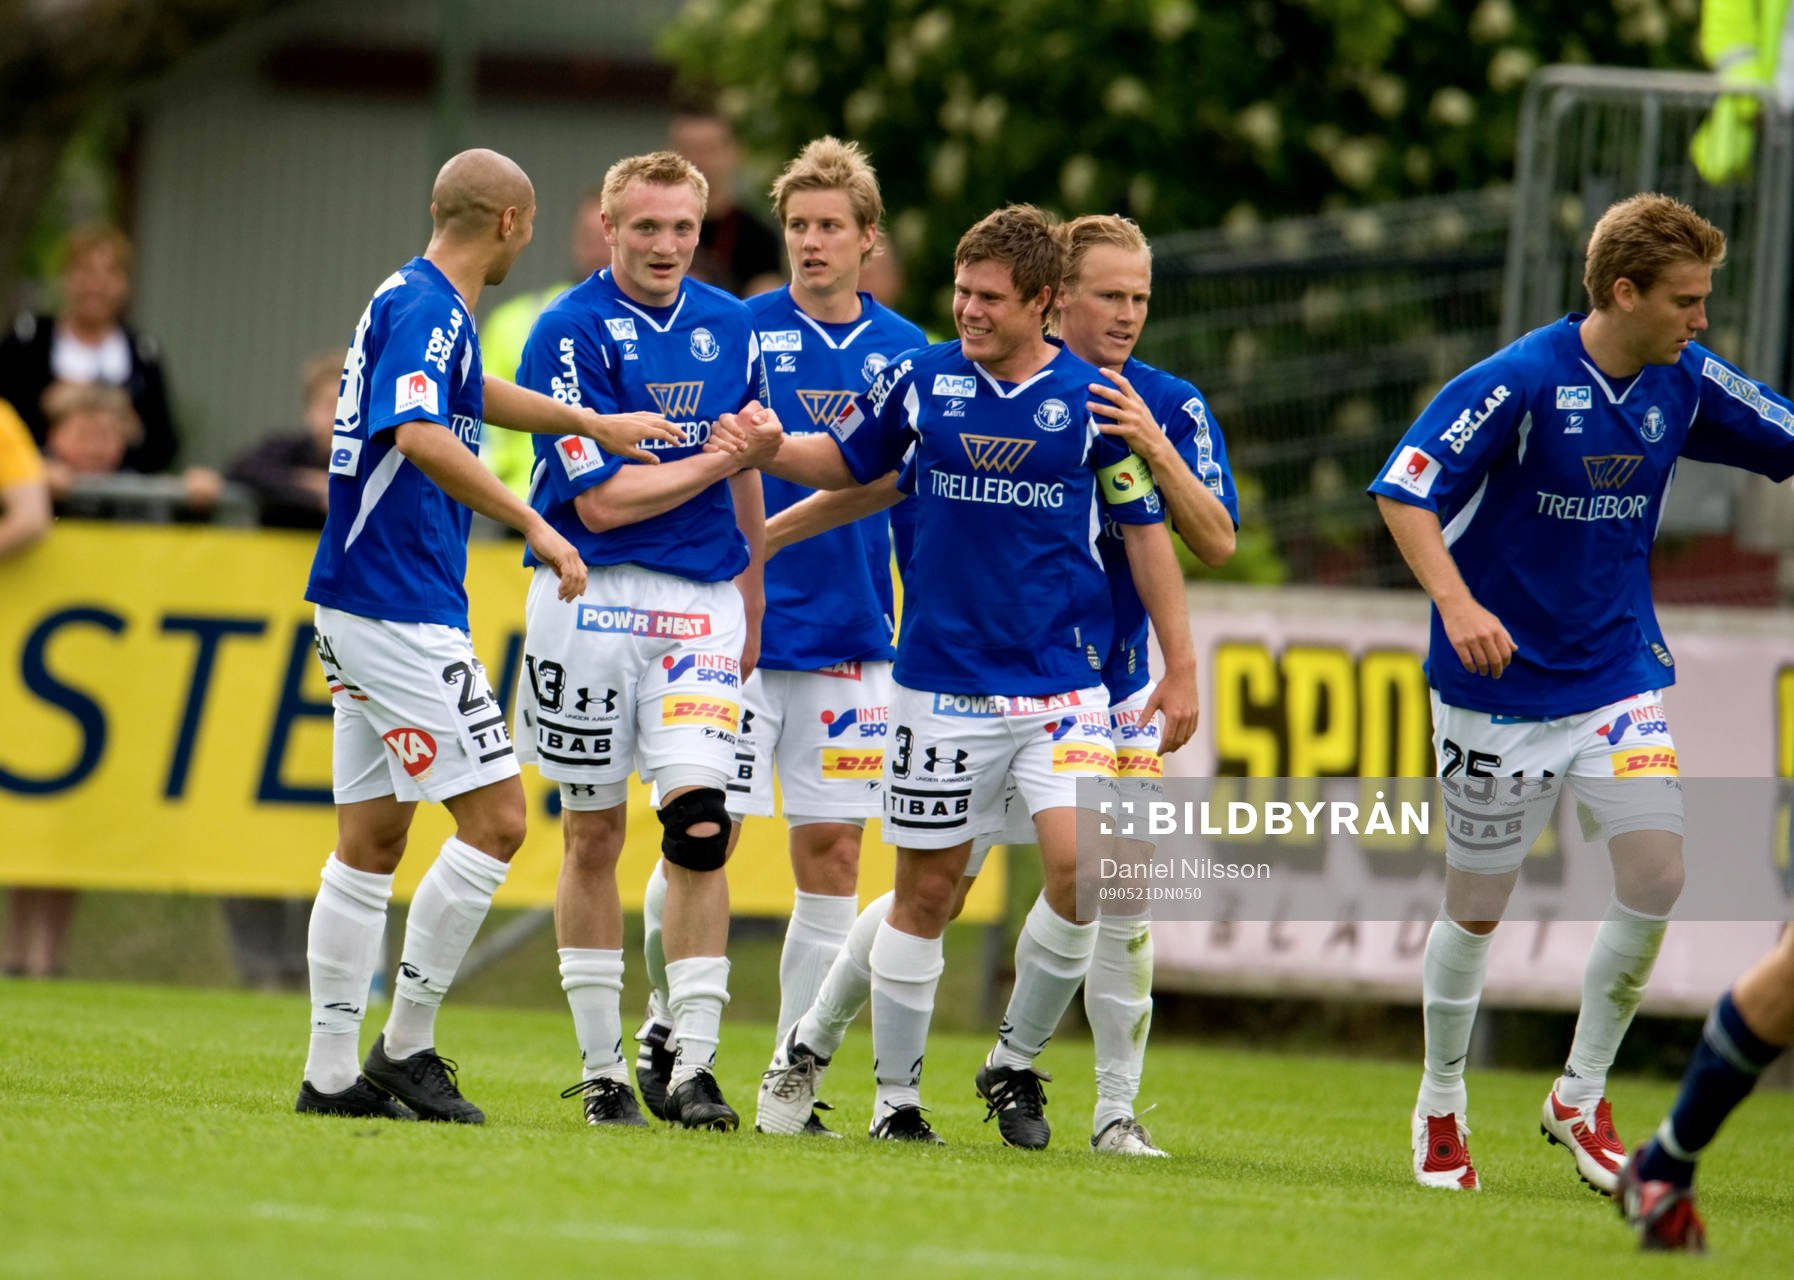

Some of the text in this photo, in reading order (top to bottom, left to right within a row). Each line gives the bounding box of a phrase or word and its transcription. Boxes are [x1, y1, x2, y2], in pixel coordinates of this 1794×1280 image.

[425, 327, 443, 363] TOP
[437, 308, 464, 374] DOLLAR
[551, 376, 568, 404] OP
[867, 373, 885, 405] TOP
[873, 359, 914, 419] DOLLAR
[1440, 408, 1471, 442] TOP
[1450, 385, 1511, 454] DOLLAR
[930, 469, 1065, 508] TRELLEBORG
[582, 608, 705, 636] POWR HEAT
[697, 654, 738, 674] INTER
[697, 668, 738, 688] SPORT
[673, 702, 732, 721] DHL
[938, 693, 1072, 713] POWER HEAT
[539, 727, 612, 754] IBAB
[892, 725, 914, 780] 3
[1064, 750, 1119, 773] DHL
[1442, 737, 1502, 806] 25
[1626, 754, 1679, 772] DHL
[891, 799, 968, 816] TIBAB
[1447, 810, 1522, 838] IBAB
[1209, 890, 1564, 960] BLADT
